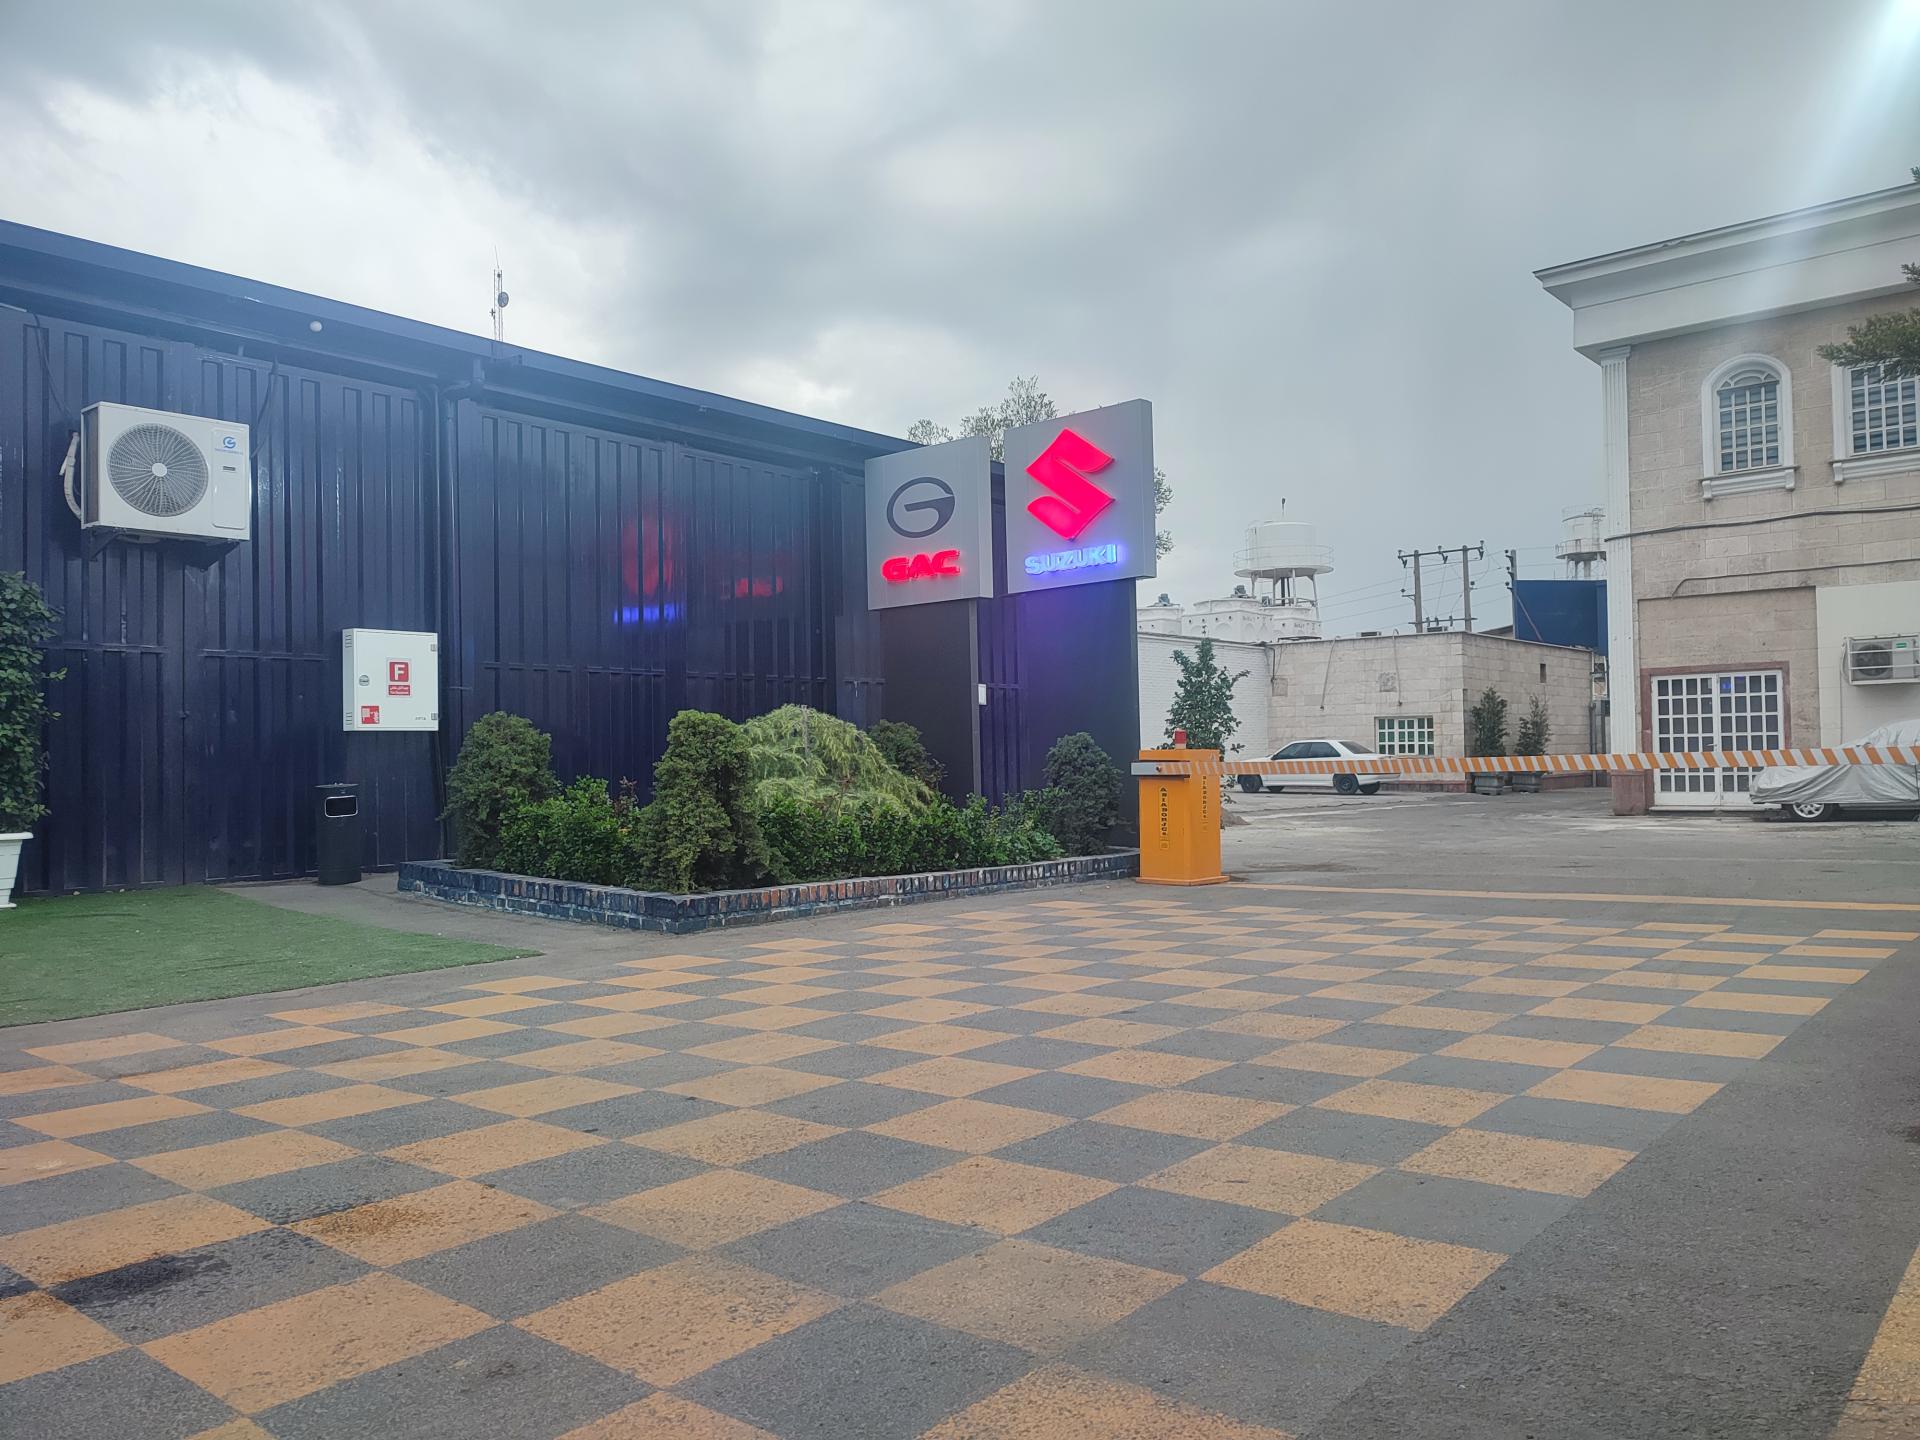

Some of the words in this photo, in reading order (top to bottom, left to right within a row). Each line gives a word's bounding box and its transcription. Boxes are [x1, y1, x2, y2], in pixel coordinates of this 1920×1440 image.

[881, 549, 960, 582] GAC
[1024, 543, 1118, 575] SUZUKI
[394, 663, 405, 680] F
